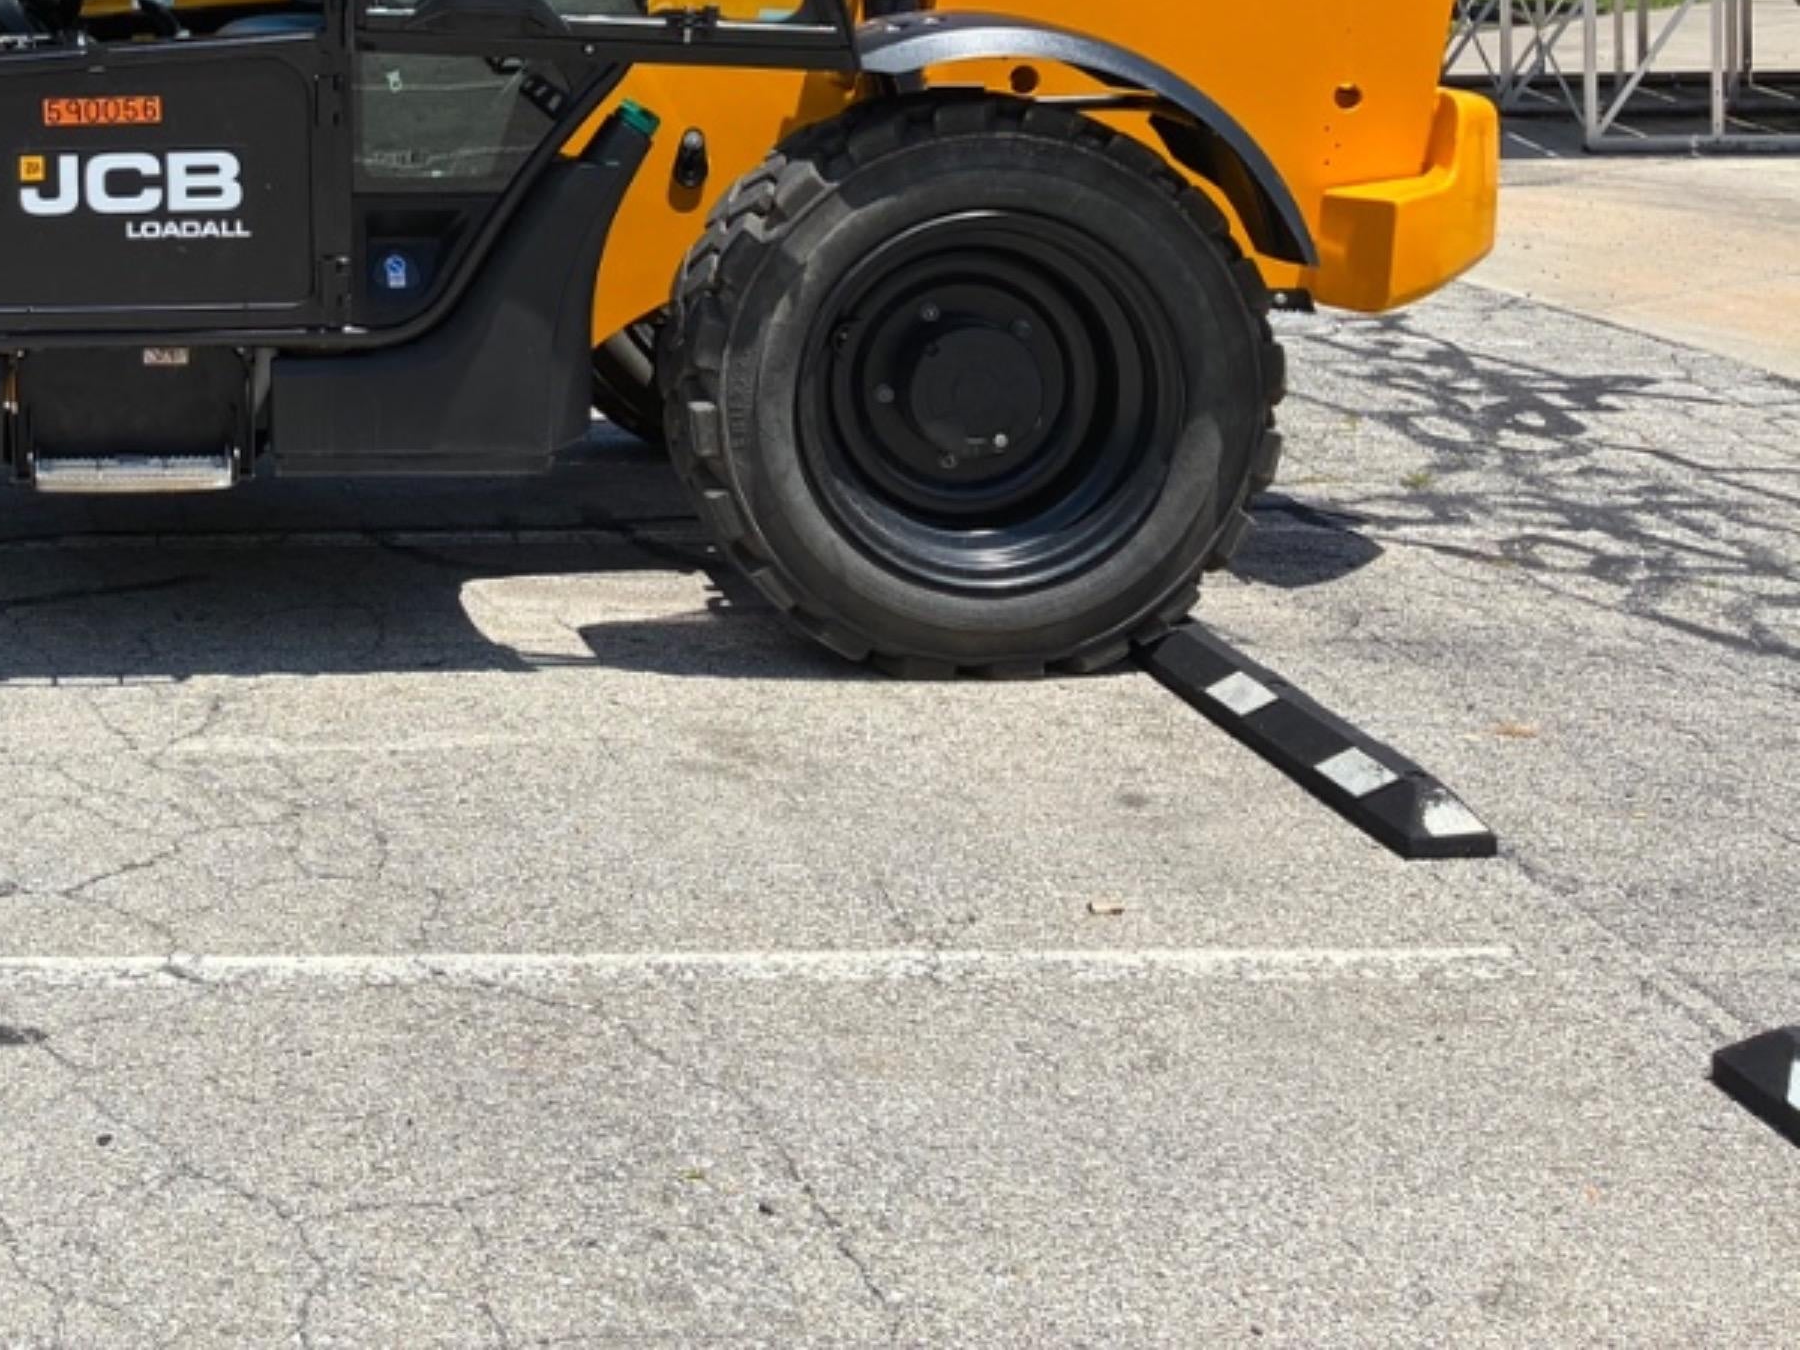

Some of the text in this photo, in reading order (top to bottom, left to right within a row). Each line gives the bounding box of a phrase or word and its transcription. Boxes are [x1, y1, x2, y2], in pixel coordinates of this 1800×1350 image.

[47, 99, 157, 124] 590056
[19, 151, 243, 215] JCB
[125, 218, 252, 239] LOADALL
